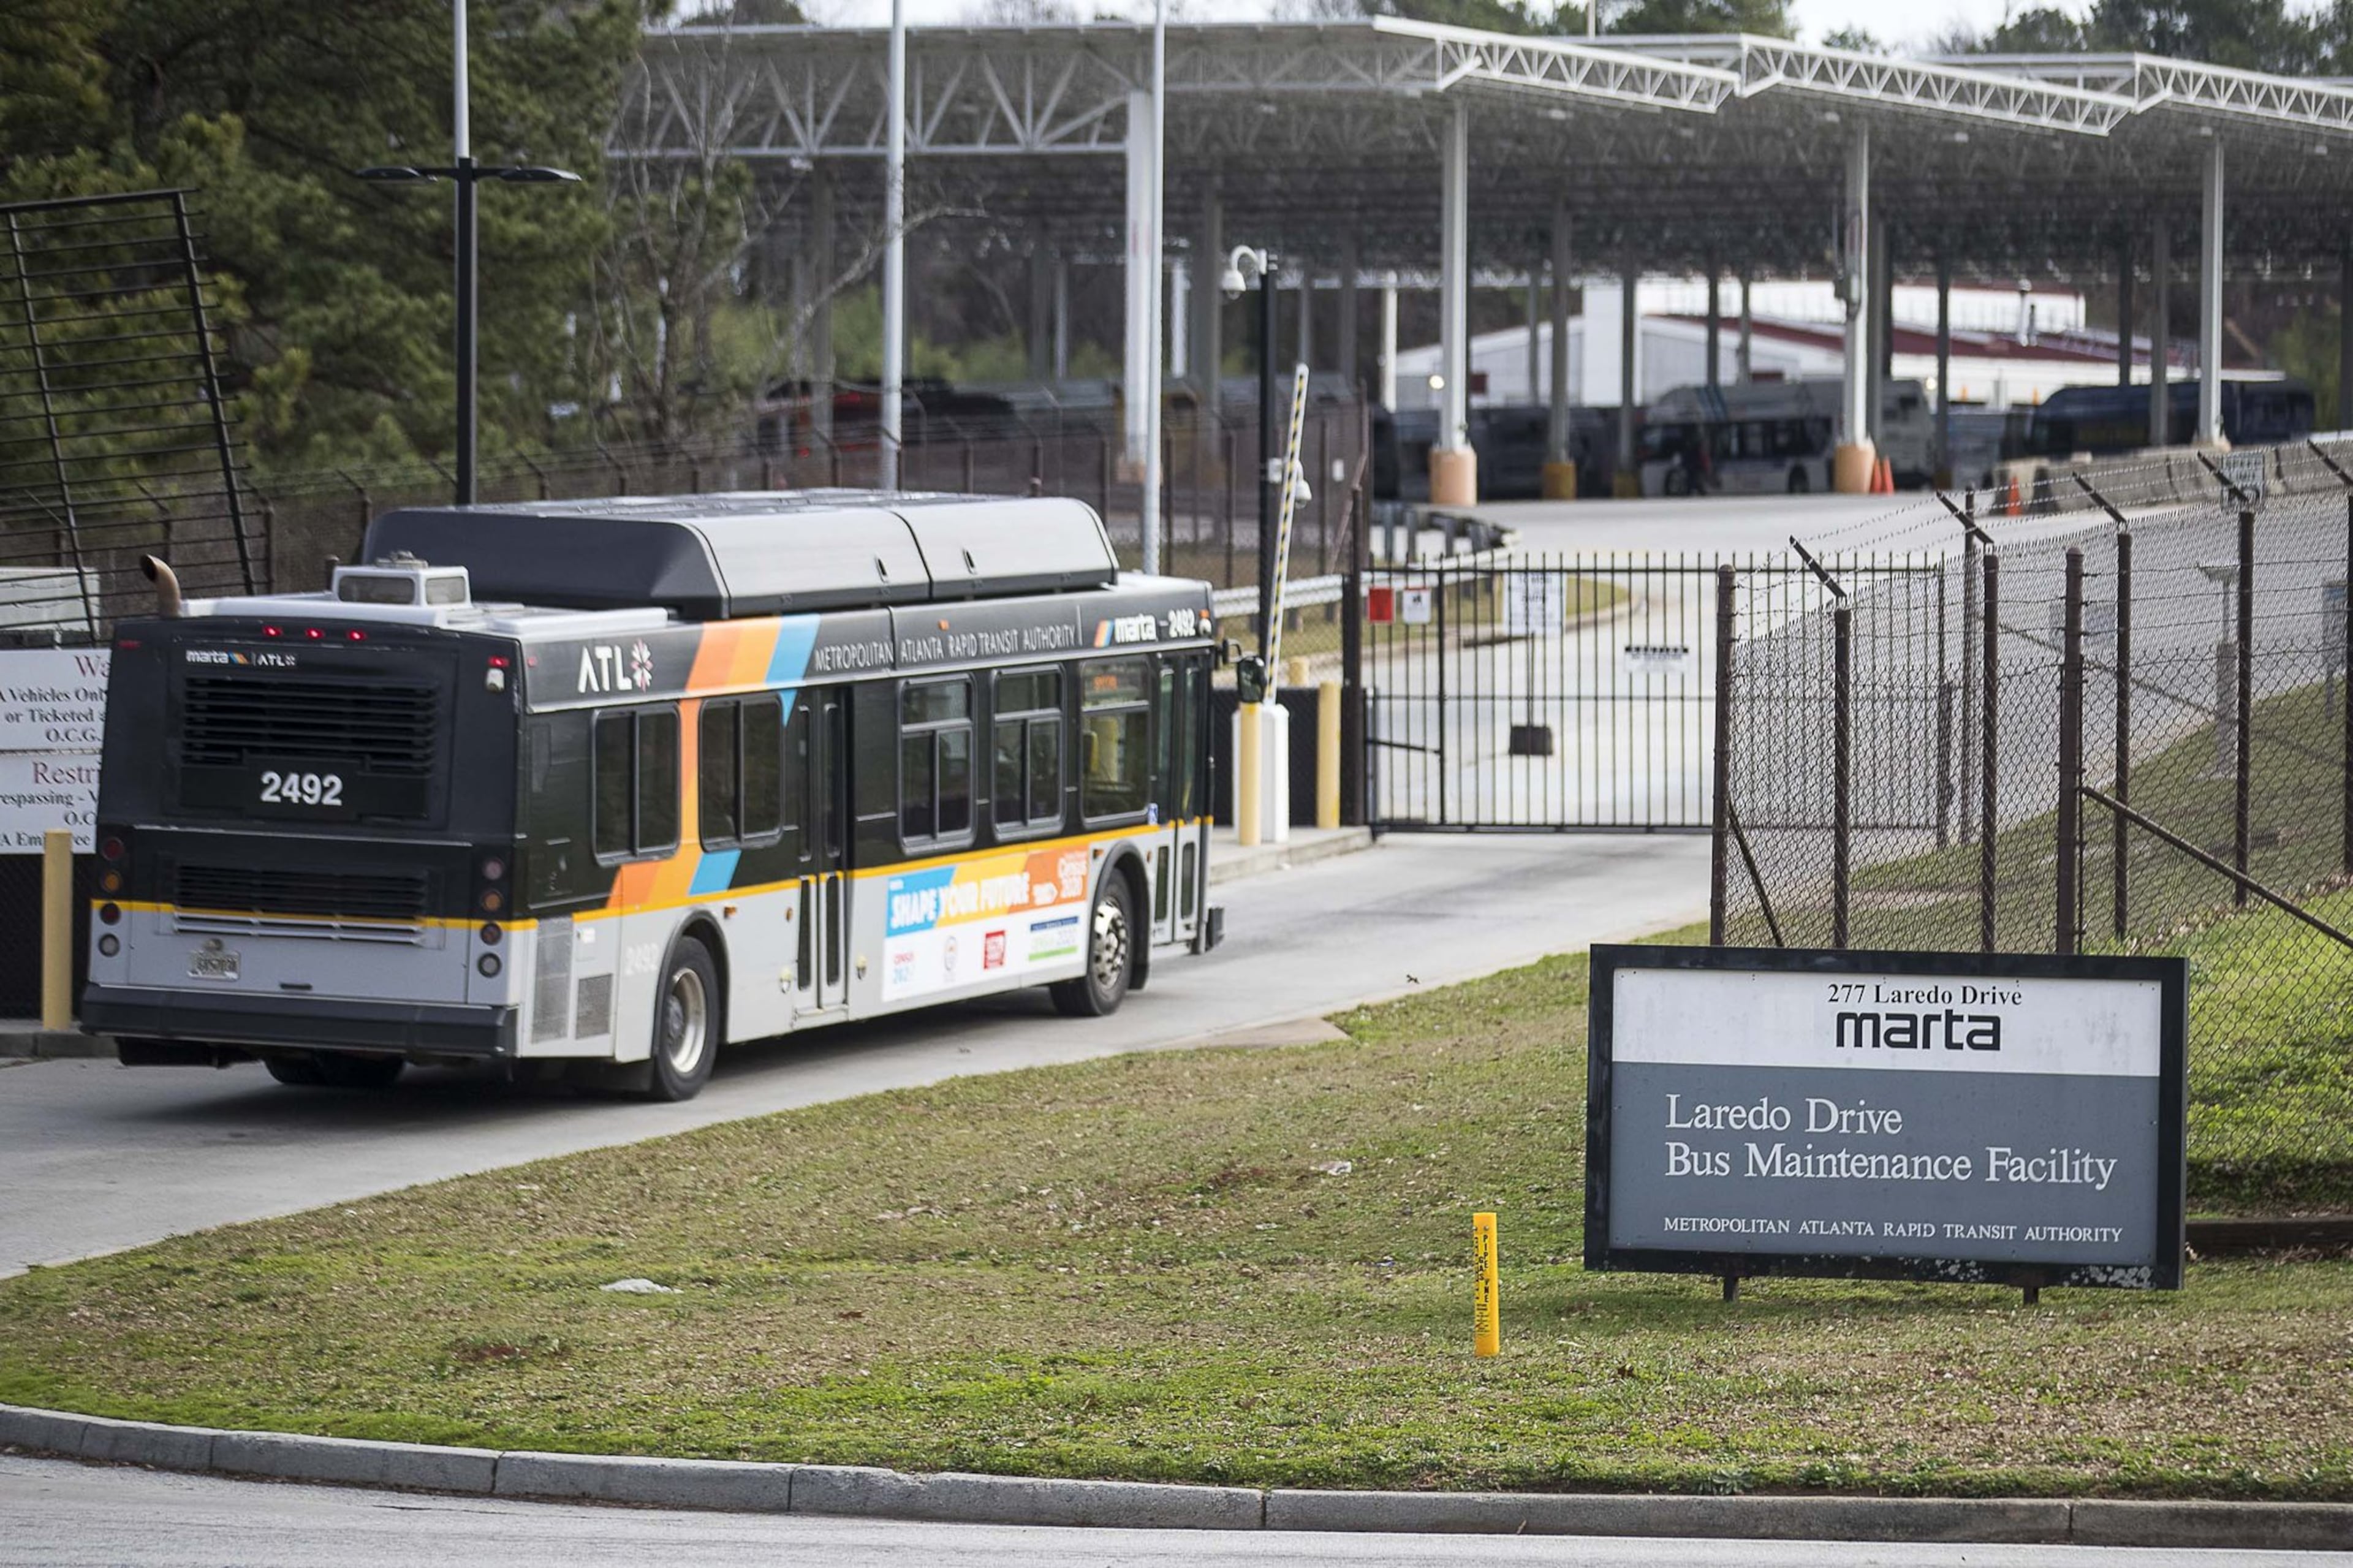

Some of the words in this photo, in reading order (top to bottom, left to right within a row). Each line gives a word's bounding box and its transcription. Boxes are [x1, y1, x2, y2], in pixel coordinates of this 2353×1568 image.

[1115, 613, 1157, 643] marta
[1168, 608, 1195, 638] 2492
[186, 650, 229, 664] marta
[257, 653, 286, 667] ATL
[816, 642, 894, 672] METROPOLITAN
[901, 636, 944, 663] ATLANTA
[948, 634, 977, 658] RAPID
[977, 629, 1018, 654] TRANSIT
[1023, 624, 1075, 651] AUTHORITY
[578, 645, 632, 693] ATL
[9, 687, 70, 702] Vehicles
[5, 711, 23, 723] or
[27, 707, 94, 723] Ticketed
[260, 771, 343, 806] 2492
[890, 888, 937, 929] SHAPE
[938, 881, 979, 918] YOUR
[980, 871, 1030, 912] FUTURE
[1828, 984, 1866, 1003] 277
[1874, 984, 1952, 1004] Laredo
[1962, 985, 2022, 1006] Drive
[1836, 1009, 2001, 1051] marta
[1665, 1094, 1792, 1131] Laredo
[1805, 1097, 1903, 1134] Drive
[1665, 1142, 1730, 1176] Bus
[1744, 1142, 1972, 1181] Maintenance
[1985, 1146, 2118, 1191] Facility
[1663, 1217, 1790, 1233] METROPOLITAN
[1798, 1220, 1875, 1237] ATLANTA
[1883, 1222, 1936, 1238] RAPID
[1942, 1223, 2017, 1240] TRANSIT
[2024, 1225, 2123, 1243] AUTHORITY
